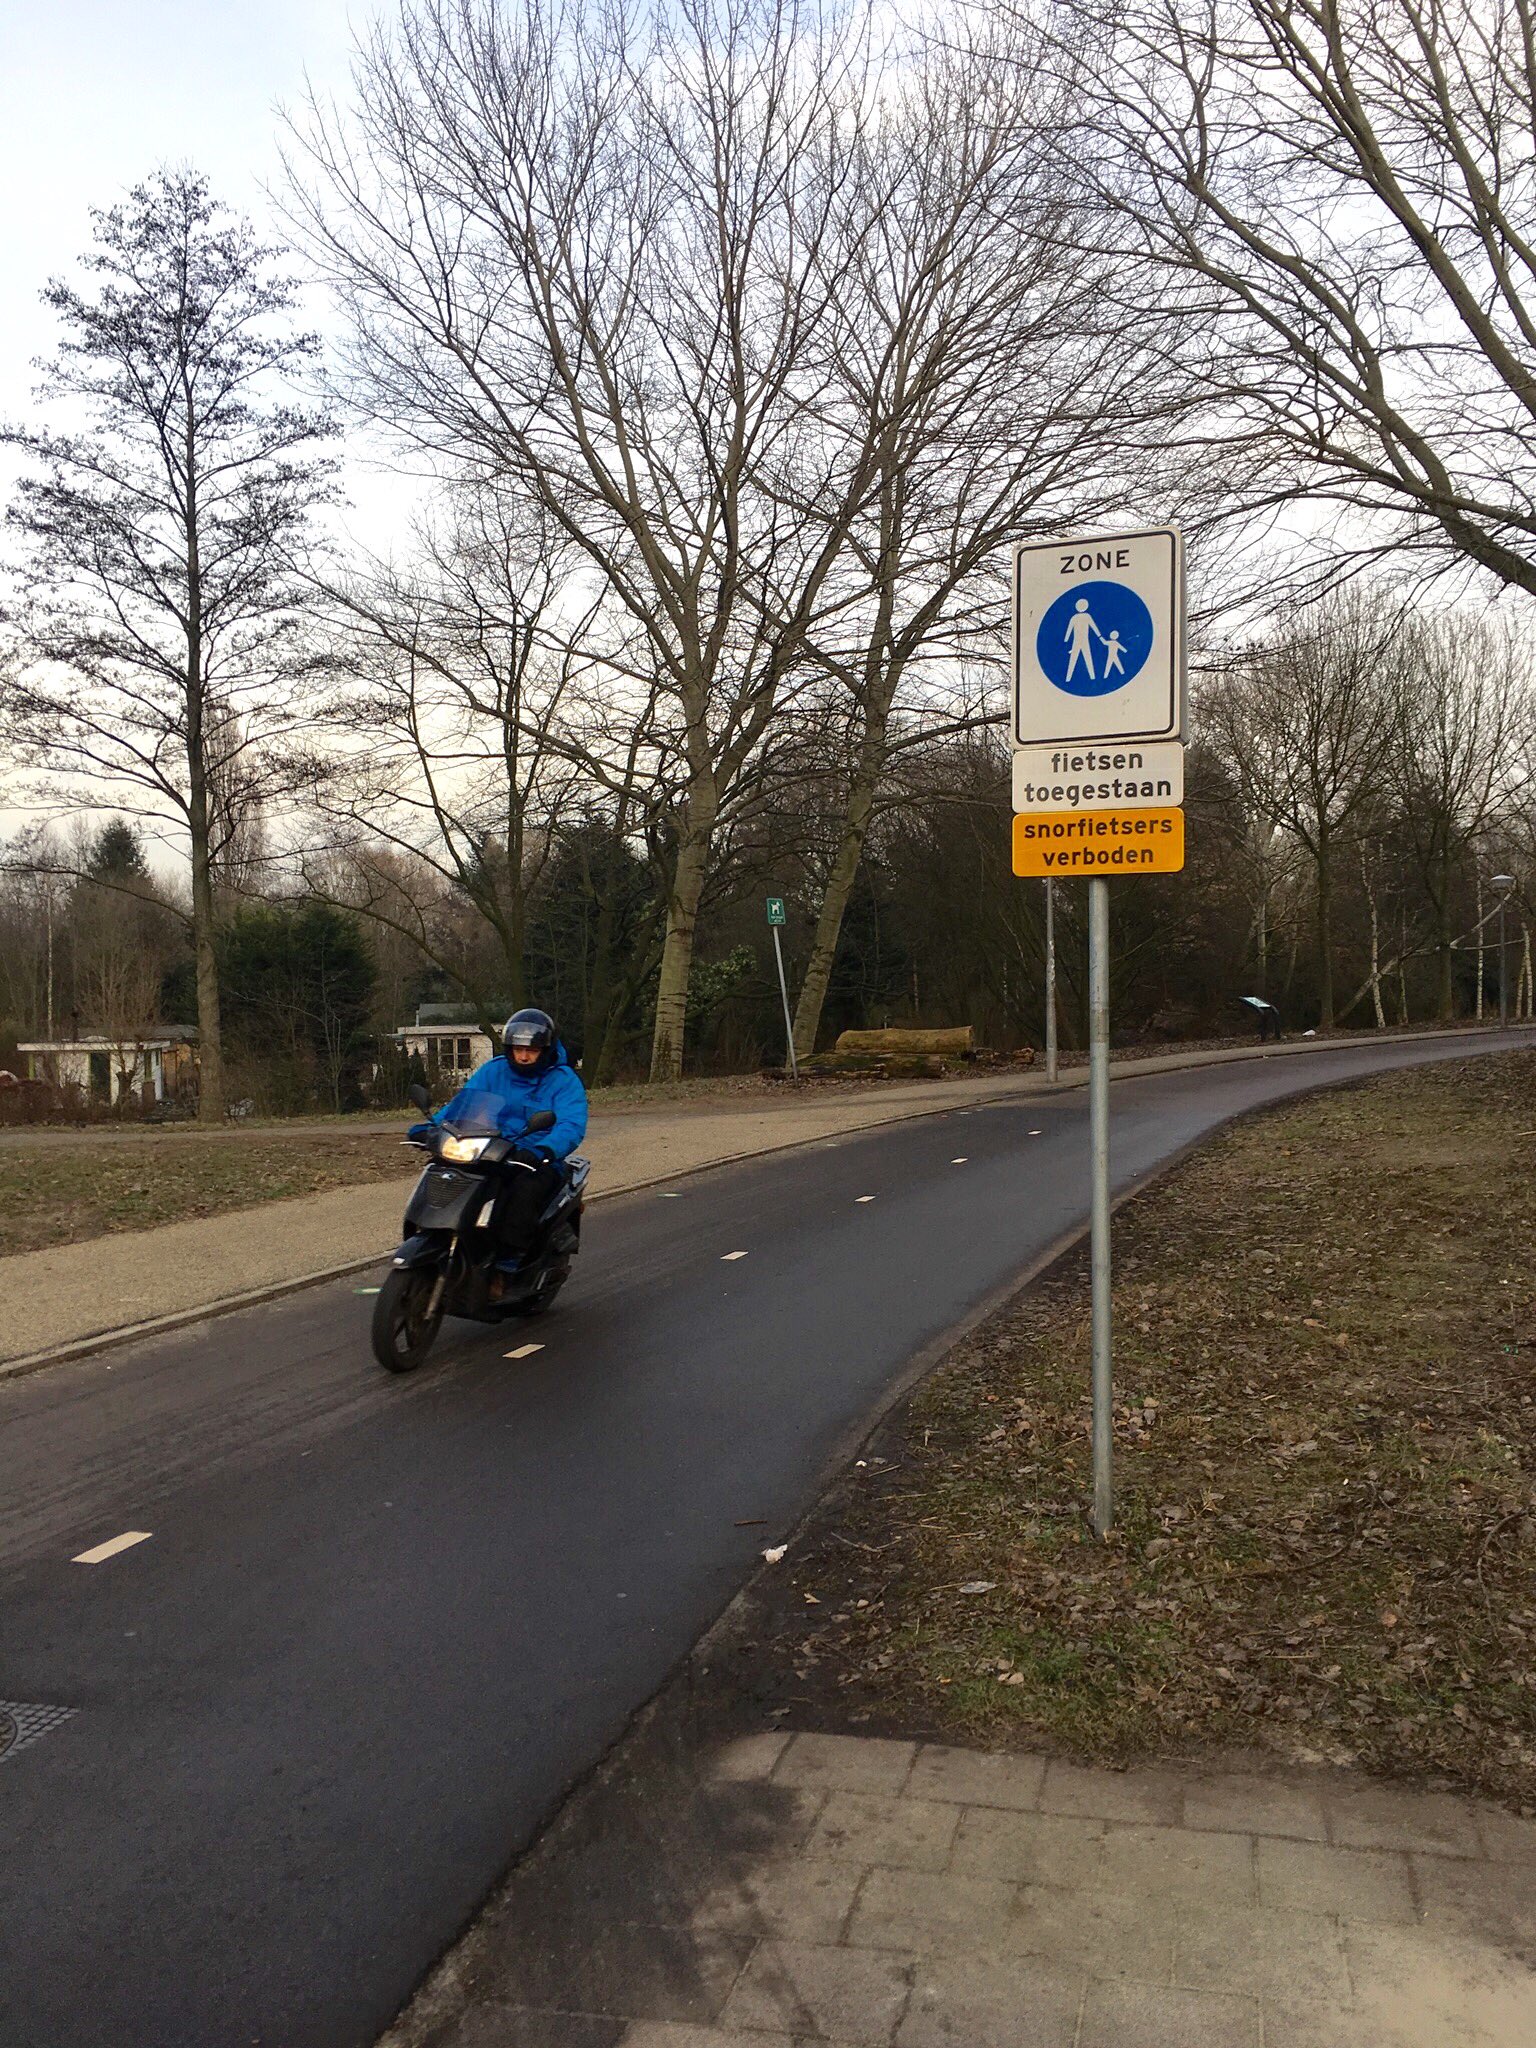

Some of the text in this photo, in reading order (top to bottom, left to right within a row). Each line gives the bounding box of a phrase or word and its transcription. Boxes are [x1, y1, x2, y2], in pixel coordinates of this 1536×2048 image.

[1060, 549, 1130, 574] ZONE
[1051, 751, 1144, 773] fietsen
[1024, 778, 1172, 807] toegestaan
[1024, 817, 1173, 839] snorfietsers
[1042, 845, 1154, 866] verboden
